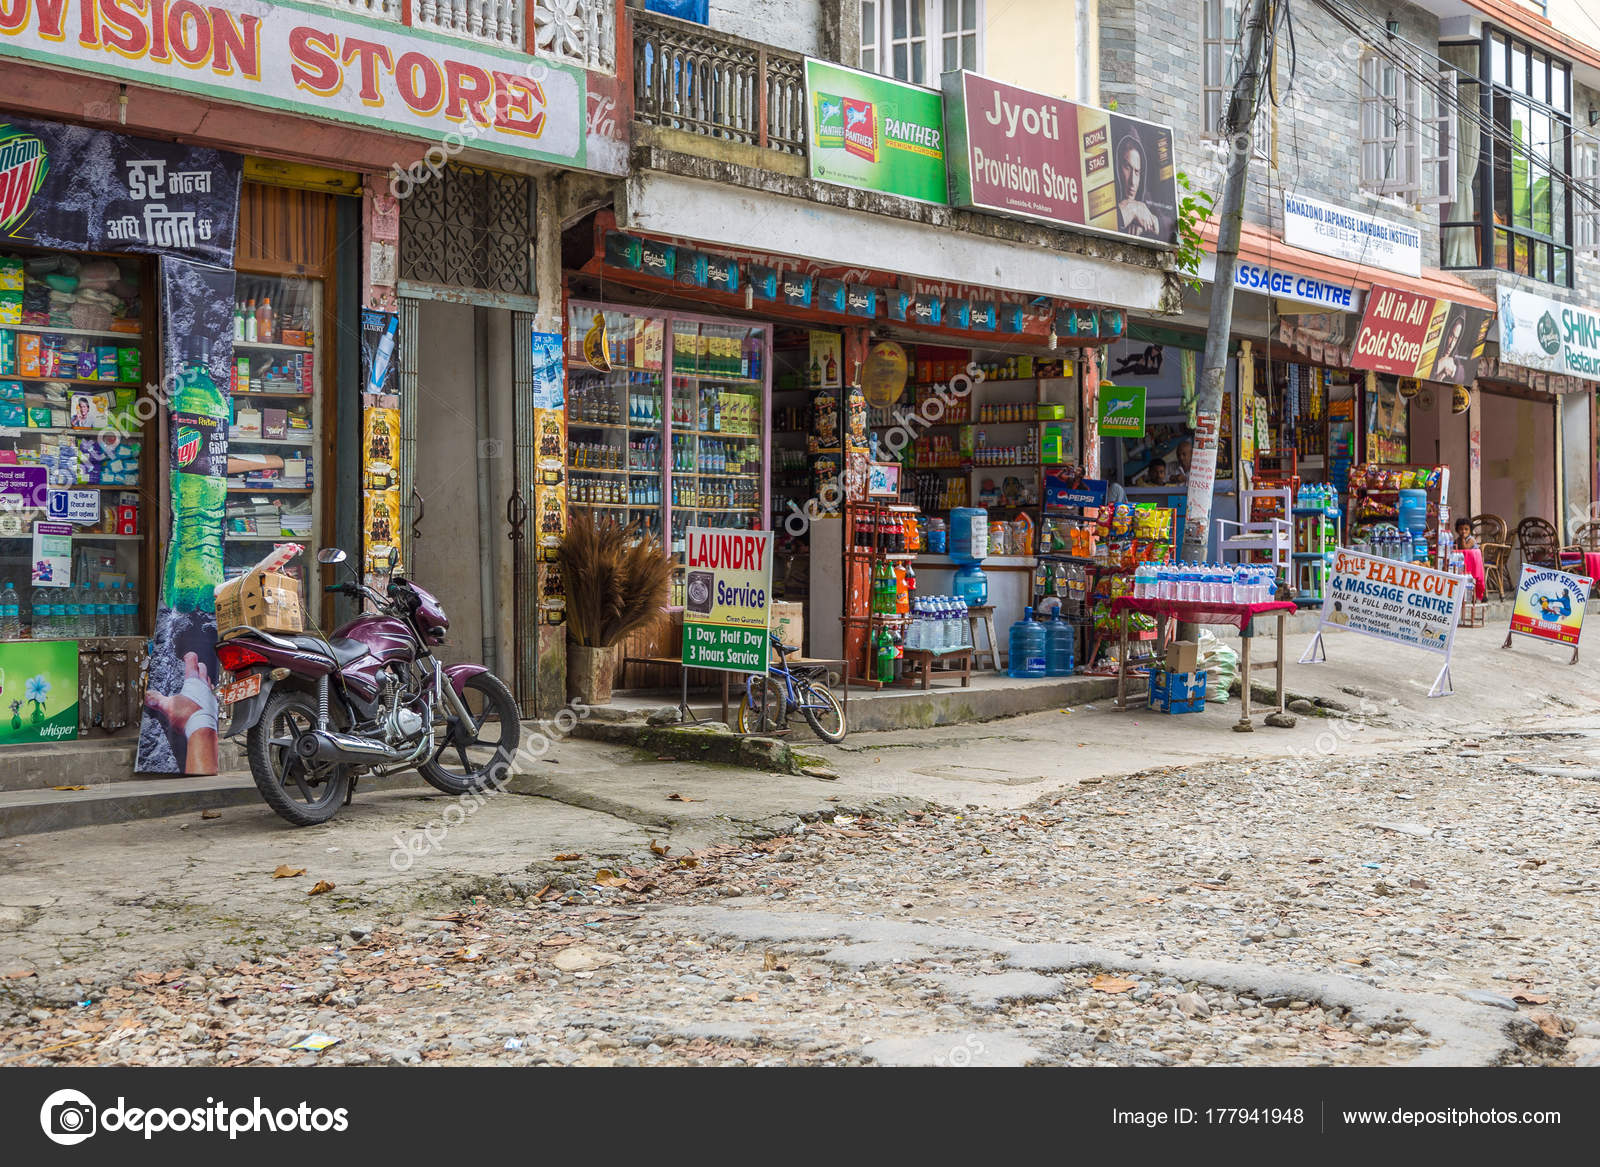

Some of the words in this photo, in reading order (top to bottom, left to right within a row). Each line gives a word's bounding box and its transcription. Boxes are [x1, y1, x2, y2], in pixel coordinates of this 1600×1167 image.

[289, 26, 546, 139] STORE
[985, 90, 1059, 141] Jyoti
[845, 129, 873, 150] PANTHER
[885, 118, 941, 150] PANTHER
[1085, 132, 1106, 148] ROYAL
[1088, 155, 1105, 170] STAG
[126, 159, 166, 200] डर
[169, 171, 212, 194] भन्दा
[974, 147, 1040, 196] Provision
[1042, 162, 1078, 204] Store
[1286, 199, 1323, 222] HANAZONO
[1324, 209, 1355, 231] JAPANESE
[1356, 219, 1388, 241] LANGUAGE
[1388, 228, 1419, 249] INSTITUTE
[644, 250, 666, 267] Carlsberg
[707, 265, 730, 282] Carlsberg
[1235, 265, 1293, 294] SSAGE
[1297, 278, 1351, 307] CENTRE
[1373, 291, 1393, 320] All
[1396, 297, 1406, 323] in
[1406, 299, 1428, 327] All
[534, 343, 562, 353] SMOOTH
[1358, 327, 1387, 358] Cold
[1388, 333, 1420, 363] Store
[1102, 416, 1140, 426] PANTHER
[210, 432, 225, 441] NEW
[209, 441, 228, 455] GRIP
[212, 455, 227, 465] PACK
[1068, 493, 1095, 503] PEPSI
[688, 533, 767, 571] LAUNDRY
[1366, 560, 1421, 591] HAIR
[1423, 574, 1458, 599] CUT
[1520, 572, 1559, 592] LAUNDRY
[1560, 575, 1586, 603] SERVICE
[717, 579, 765, 609] Service
[1332, 575, 1342, 591] &
[1345, 578, 1404, 603] MASSAGE
[1407, 592, 1454, 615] CENTRE
[1332, 591, 1351, 602] HALF
[1361, 597, 1380, 609] FULL
[1382, 600, 1404, 614] BODY
[1530, 618, 1536, 626] 3
[1538, 620, 1562, 631] HOURS
[688, 627, 692, 640] 1
[696, 628, 717, 644] Day,
[720, 629, 742, 645] Half
[743, 631, 763, 648] Day
[690, 645, 696, 660] 3
[698, 645, 725, 663] Hours
[727, 648, 759, 665] Service
[40, 723, 76, 740] whisper
